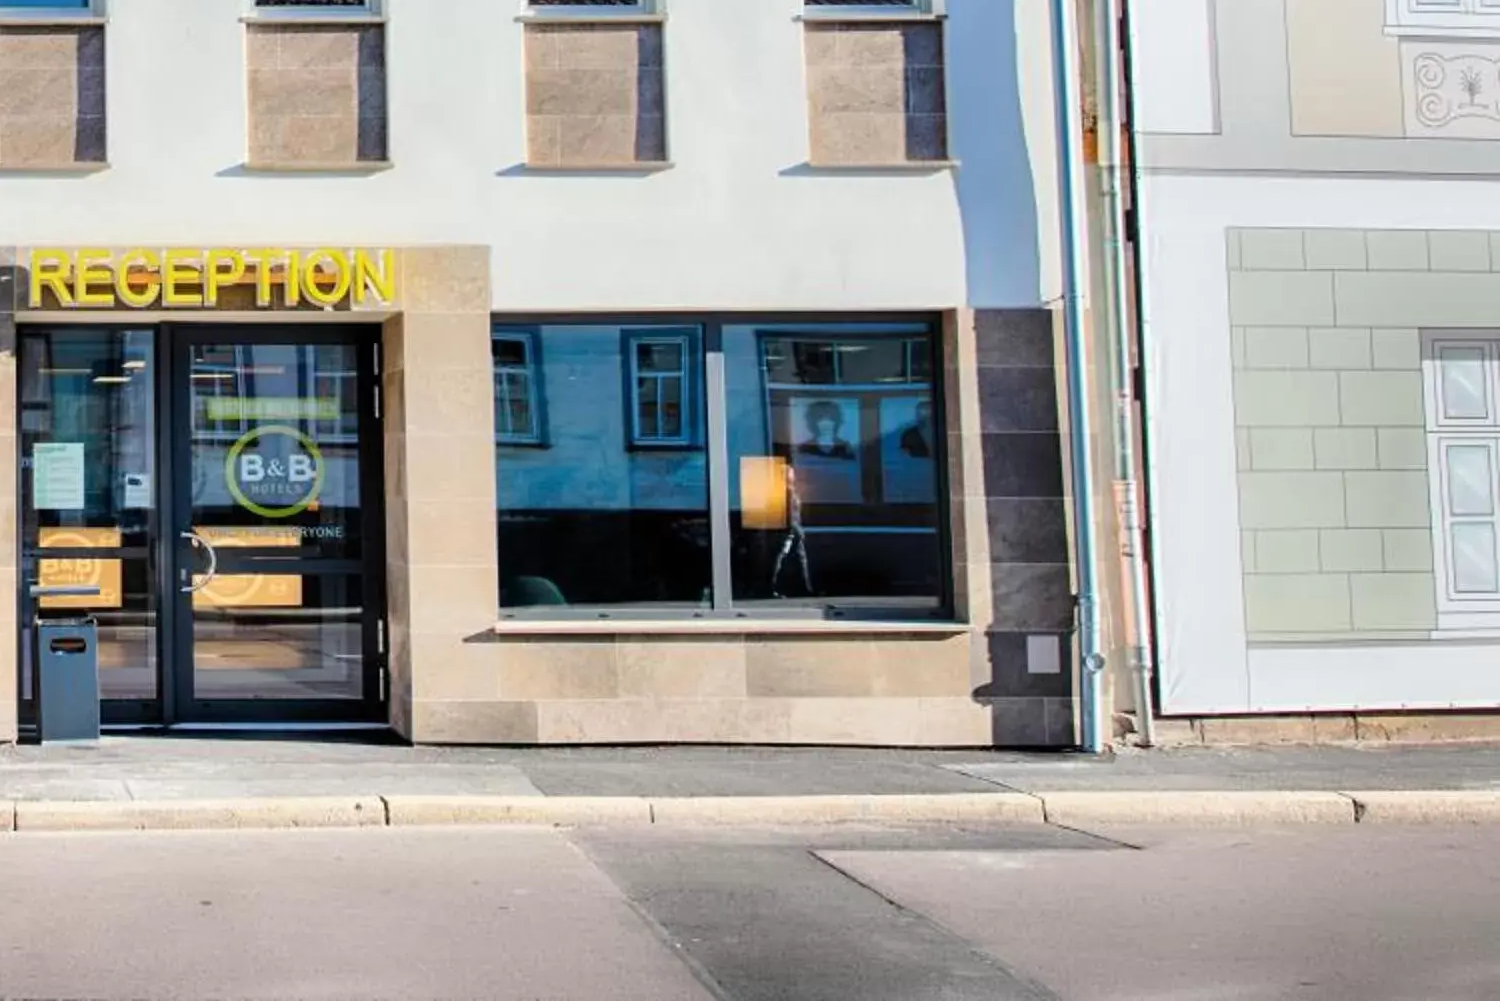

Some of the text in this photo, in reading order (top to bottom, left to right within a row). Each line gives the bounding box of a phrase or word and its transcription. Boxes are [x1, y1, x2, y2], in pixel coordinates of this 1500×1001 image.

[29, 247, 395, 309] RECEPTION
[241, 454, 314, 483] B&B
[251, 482, 302, 494] HOTELS
